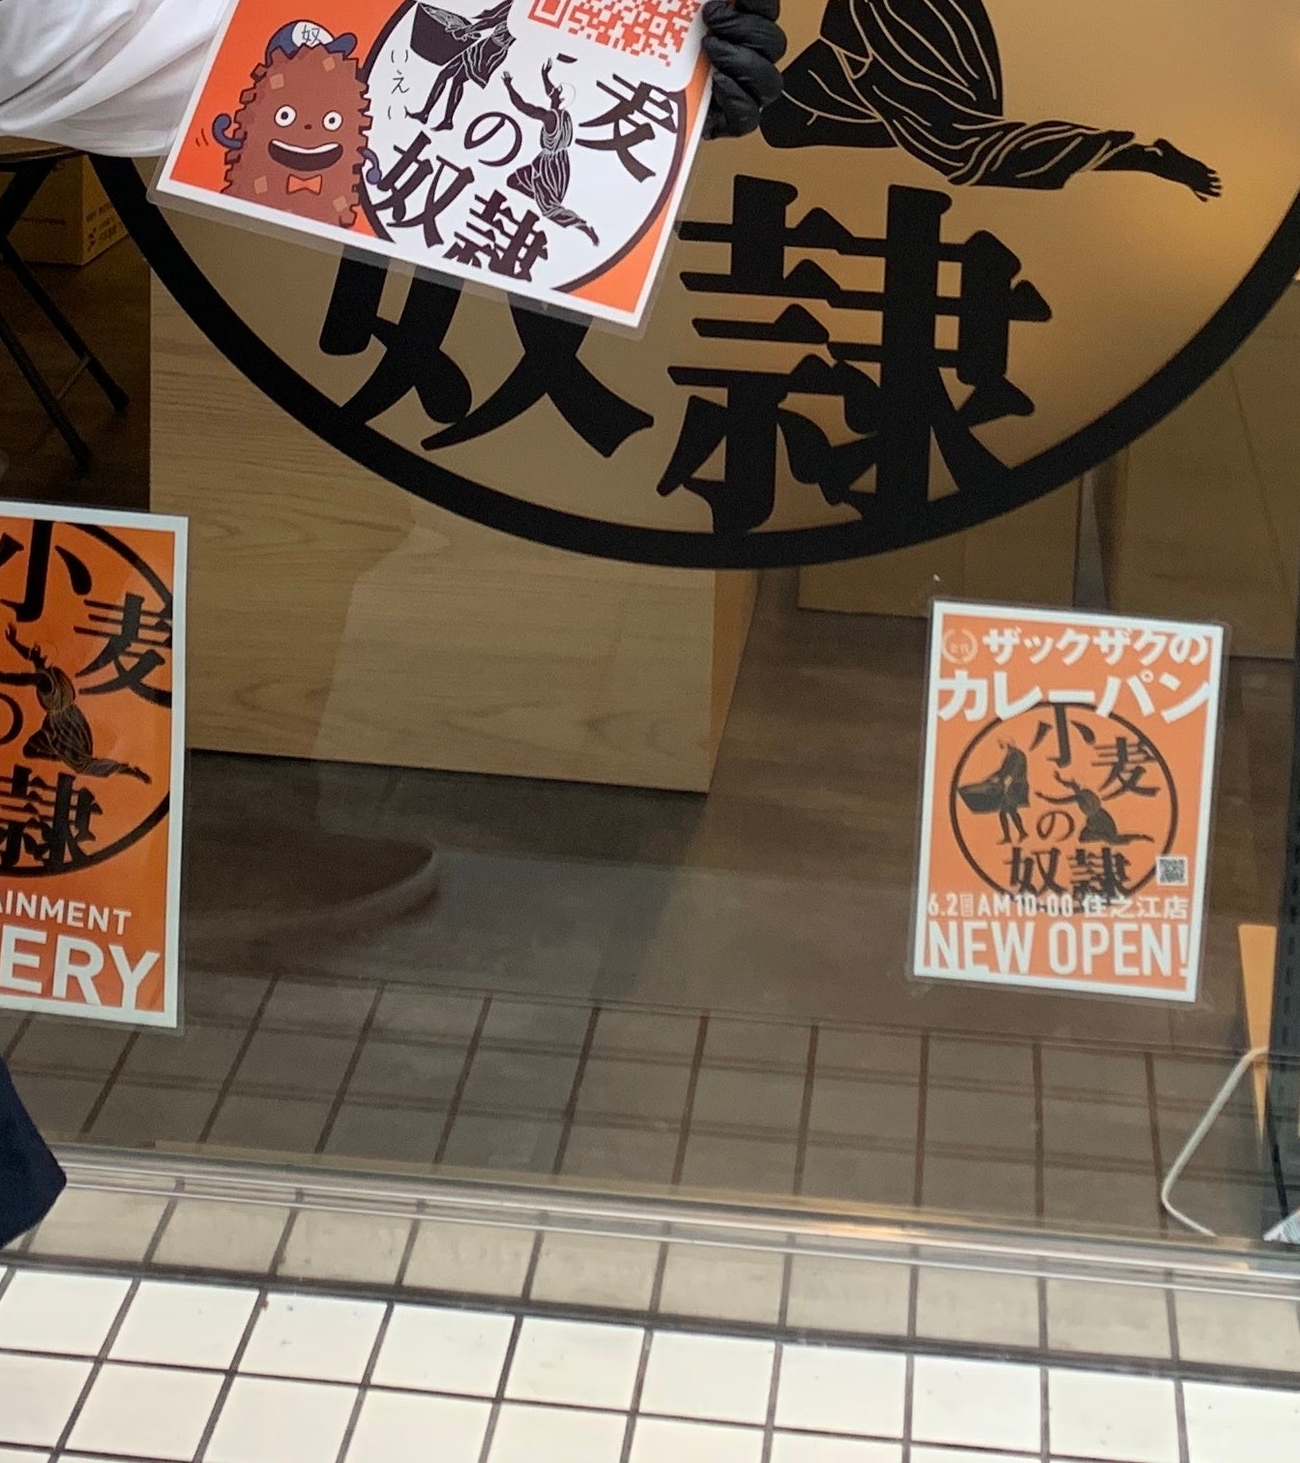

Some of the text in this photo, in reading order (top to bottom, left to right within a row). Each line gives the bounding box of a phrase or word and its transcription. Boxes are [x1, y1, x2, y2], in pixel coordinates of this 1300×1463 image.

[465, 111, 522, 166] の
[982, 628, 1208, 666] ザックザクの
[937, 669, 1209, 723] カレーパン
[1030, 703, 1159, 801] 小麦
[1036, 810, 1074, 839] の
[928, 893, 958, 916] 6.2
[1083, 895, 1188, 919] 住之江店
[929, 920, 1188, 976] NEW OPEN!
